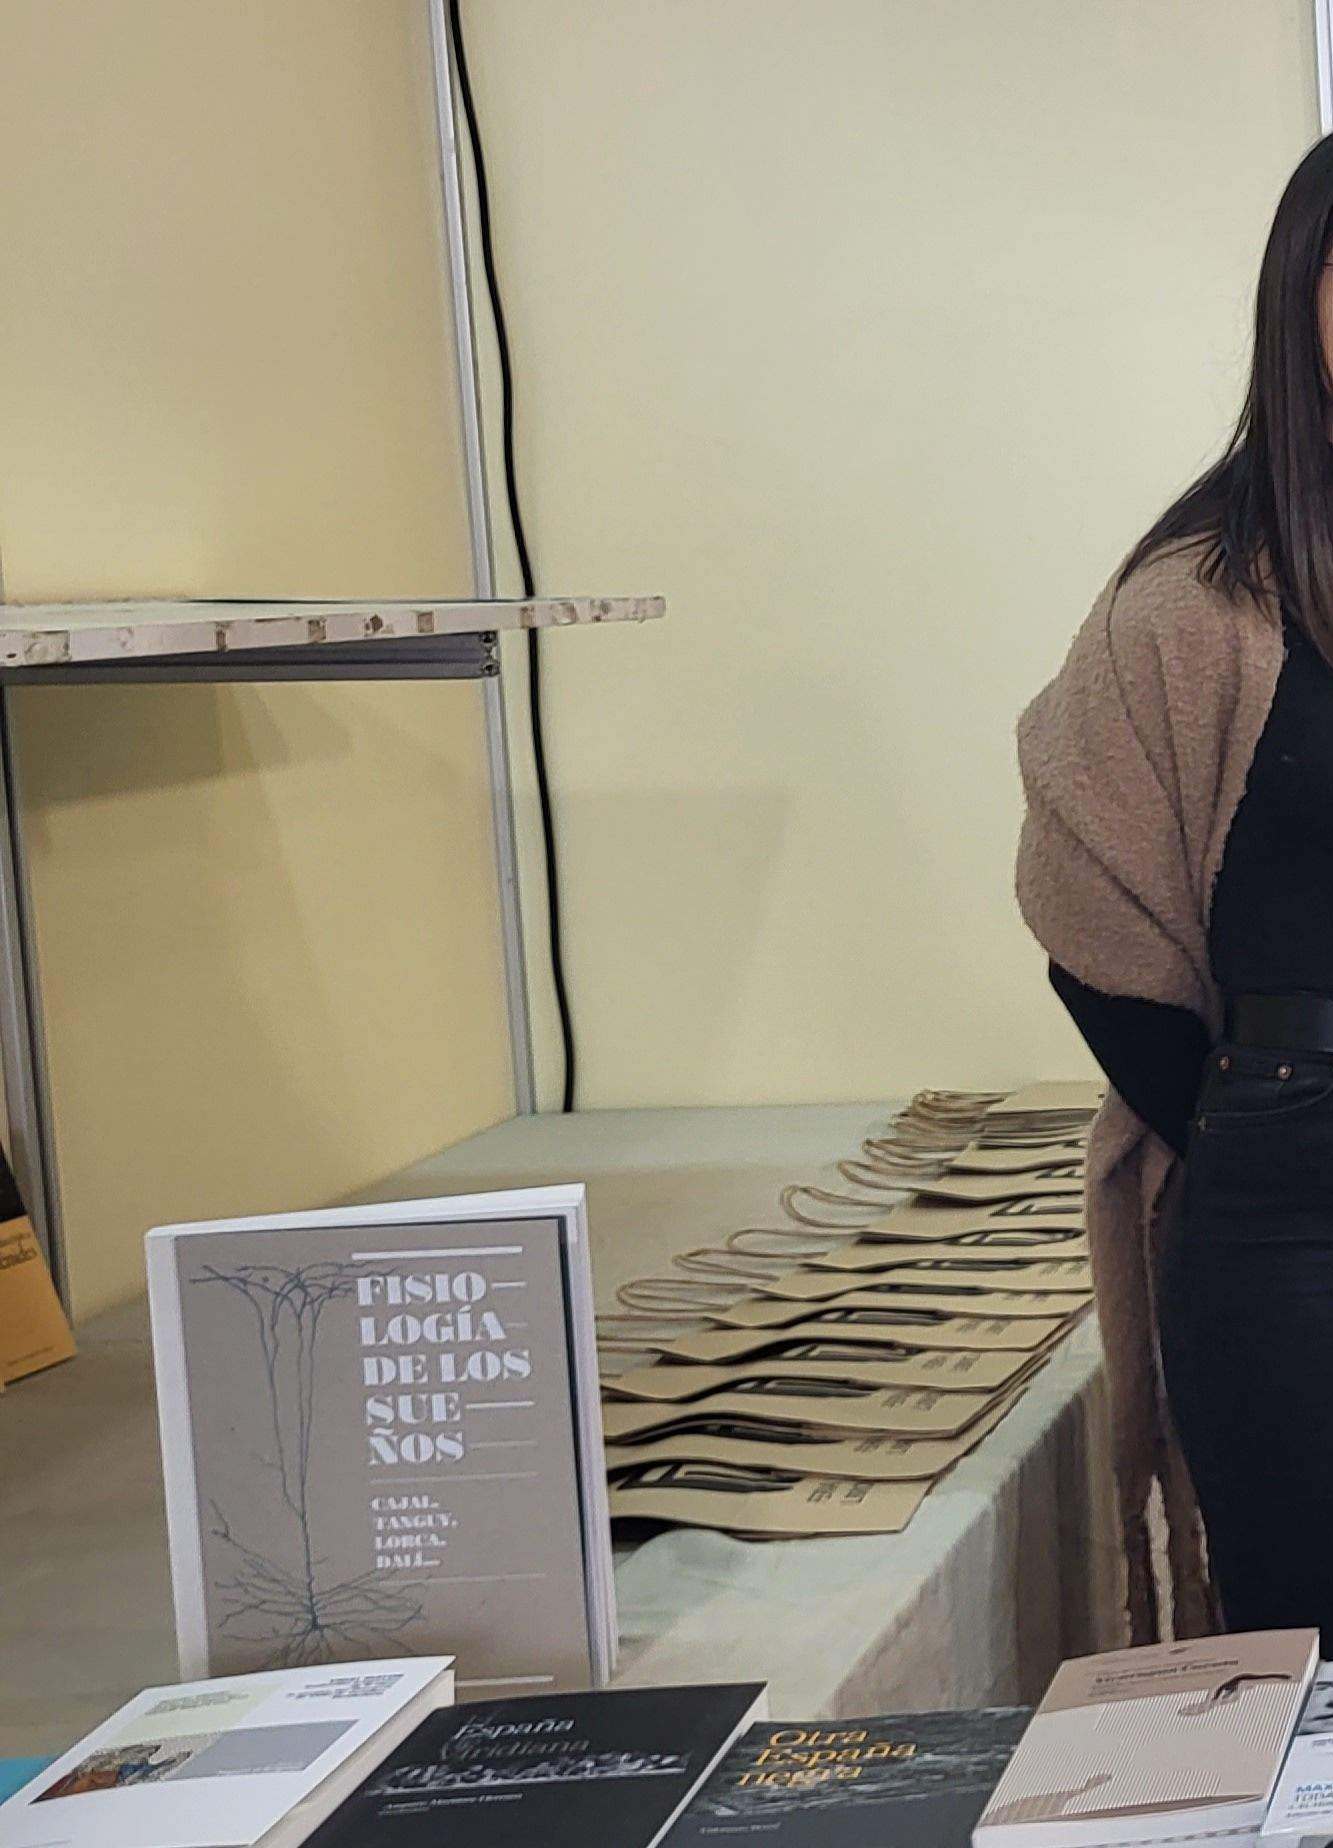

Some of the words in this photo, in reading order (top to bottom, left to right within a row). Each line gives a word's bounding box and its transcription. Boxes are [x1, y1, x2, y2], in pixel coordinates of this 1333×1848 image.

[360, 1304, 507, 1345] LOGÍA
[363, 1354, 429, 1386] DE
[440, 1350, 532, 1382] LOS
[366, 1392, 462, 1425] SUE
[368, 1427, 464, 1466] ÑOS
[453, 1717, 575, 1741] España
[769, 1729, 868, 1746] Otra
[754, 1741, 917, 1768] España
[736, 1764, 863, 1789] negra
[1296, 1783, 1333, 1794] MAX
